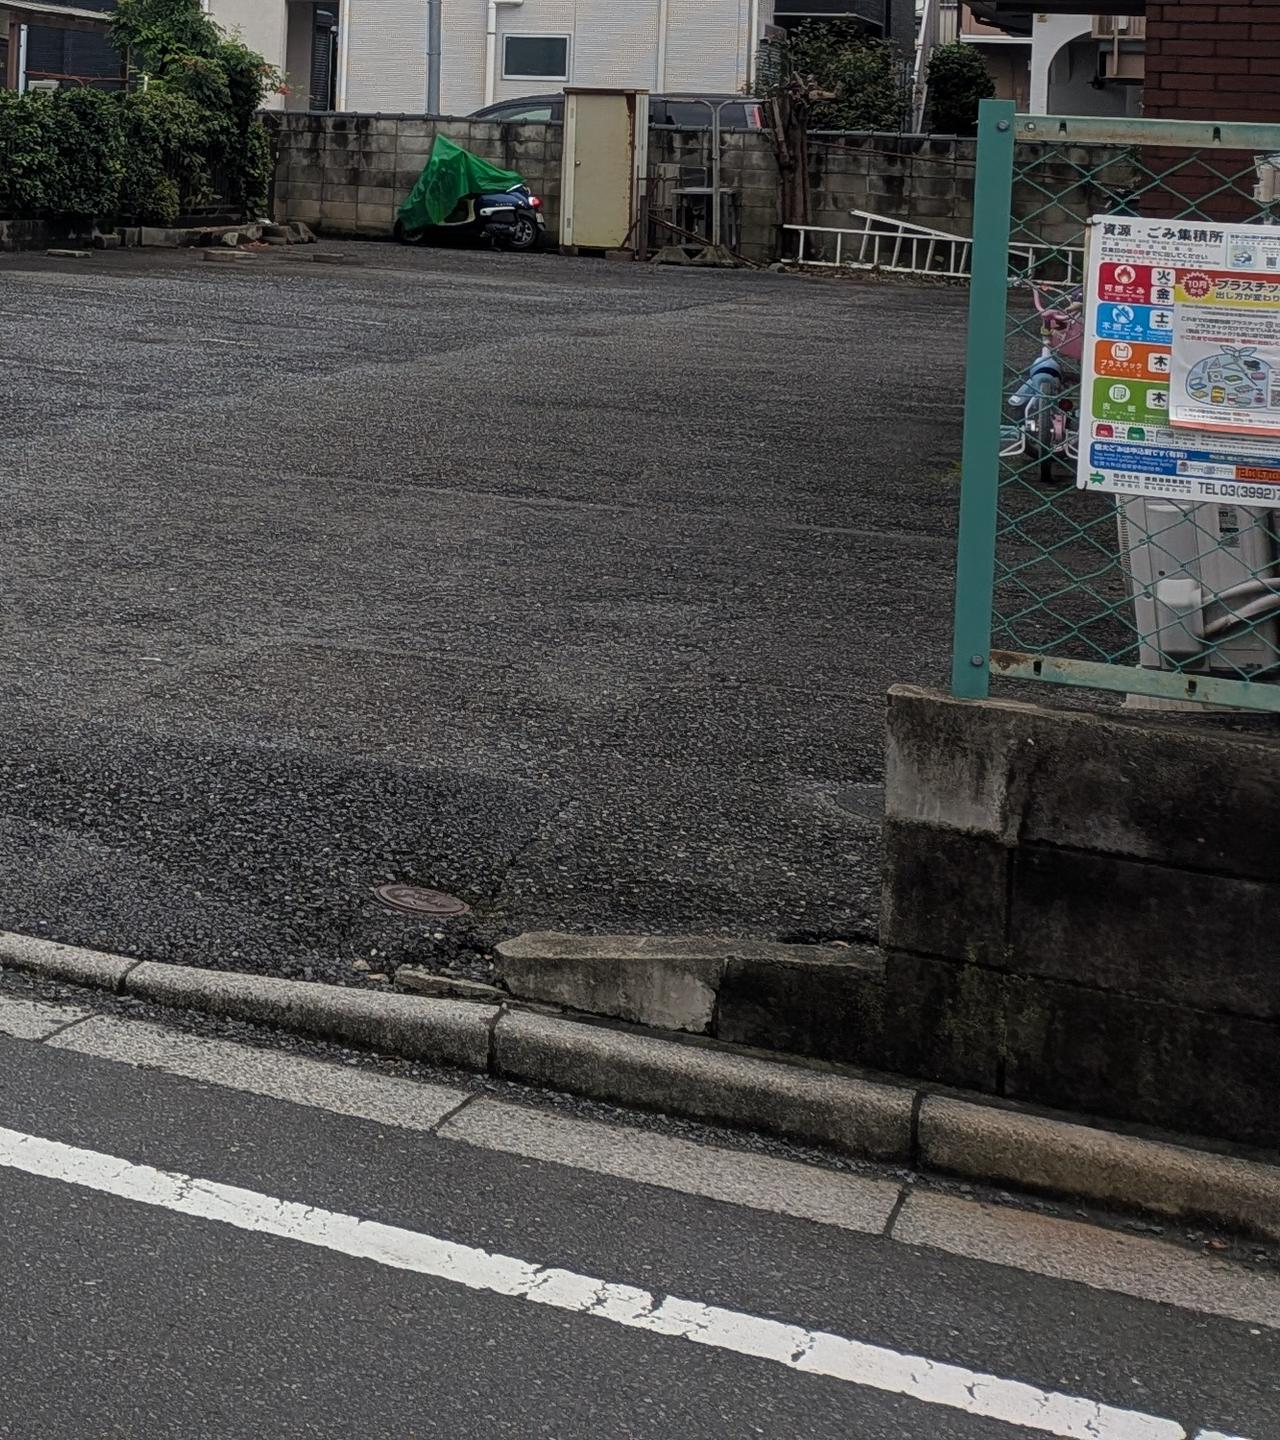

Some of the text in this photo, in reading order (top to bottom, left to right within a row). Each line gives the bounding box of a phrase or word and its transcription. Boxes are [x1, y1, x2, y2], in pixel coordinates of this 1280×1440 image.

[1103, 222, 1224, 244] 資源・ごみ集積所
[1157, 270, 1171, 282] 火
[1188, 280, 1207, 289] 10月
[1156, 288, 1170, 301] 金
[1155, 312, 1169, 324] 土
[1154, 356, 1168, 367] 木
[1152, 392, 1166, 403] 木
[1198, 481, 1219, 495] TEL
[1220, 484, 1280, 501] 03(3992)
